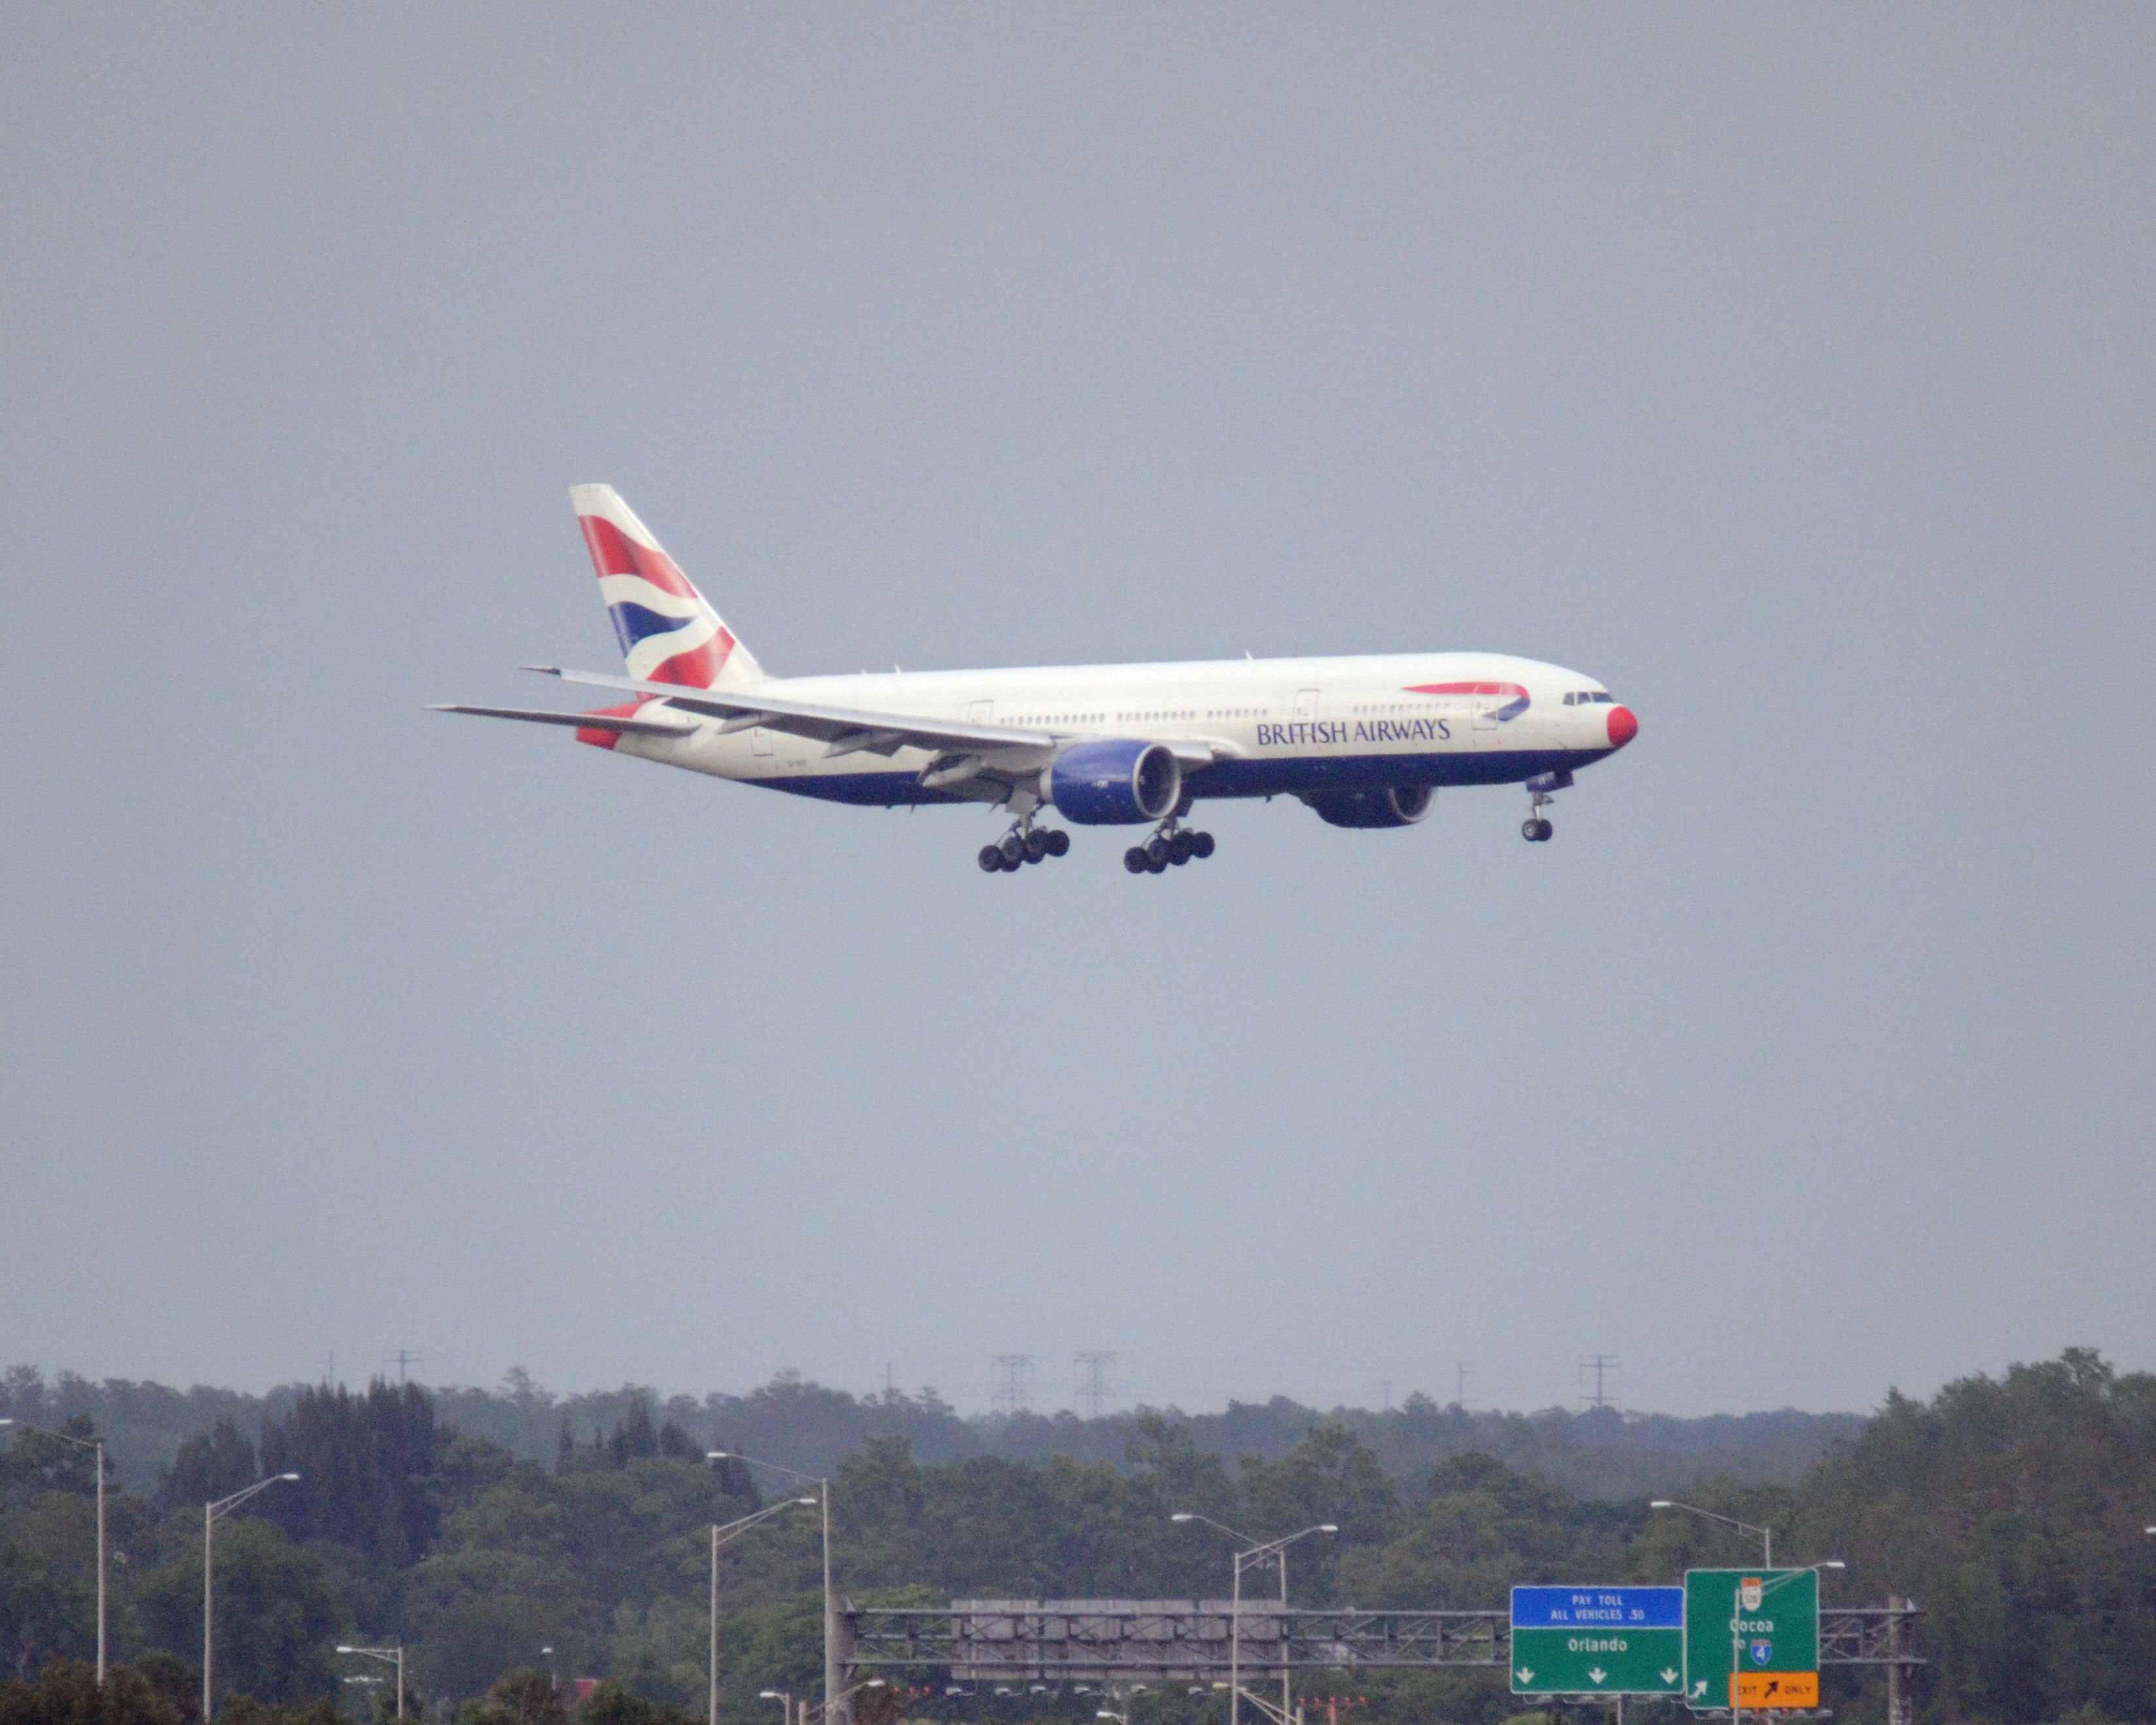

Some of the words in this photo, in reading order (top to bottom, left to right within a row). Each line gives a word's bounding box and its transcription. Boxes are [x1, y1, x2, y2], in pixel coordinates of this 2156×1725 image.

[1257, 722, 1347, 745] BRITISH
[1353, 718, 1451, 742] AIRWAYS
[1572, 1595, 1592, 1605] PAY
[1599, 1595, 1623, 1605] TOLL
[1551, 1609, 1568, 1620] ALL
[1575, 1609, 1622, 1620] VEHICLES
[1730, 1619, 1774, 1632] Cocoa
[1568, 1637, 1627, 1651] Orlando
[1757, 1646, 1765, 1659] 4
[1784, 1686, 1811, 1694] ONLY
